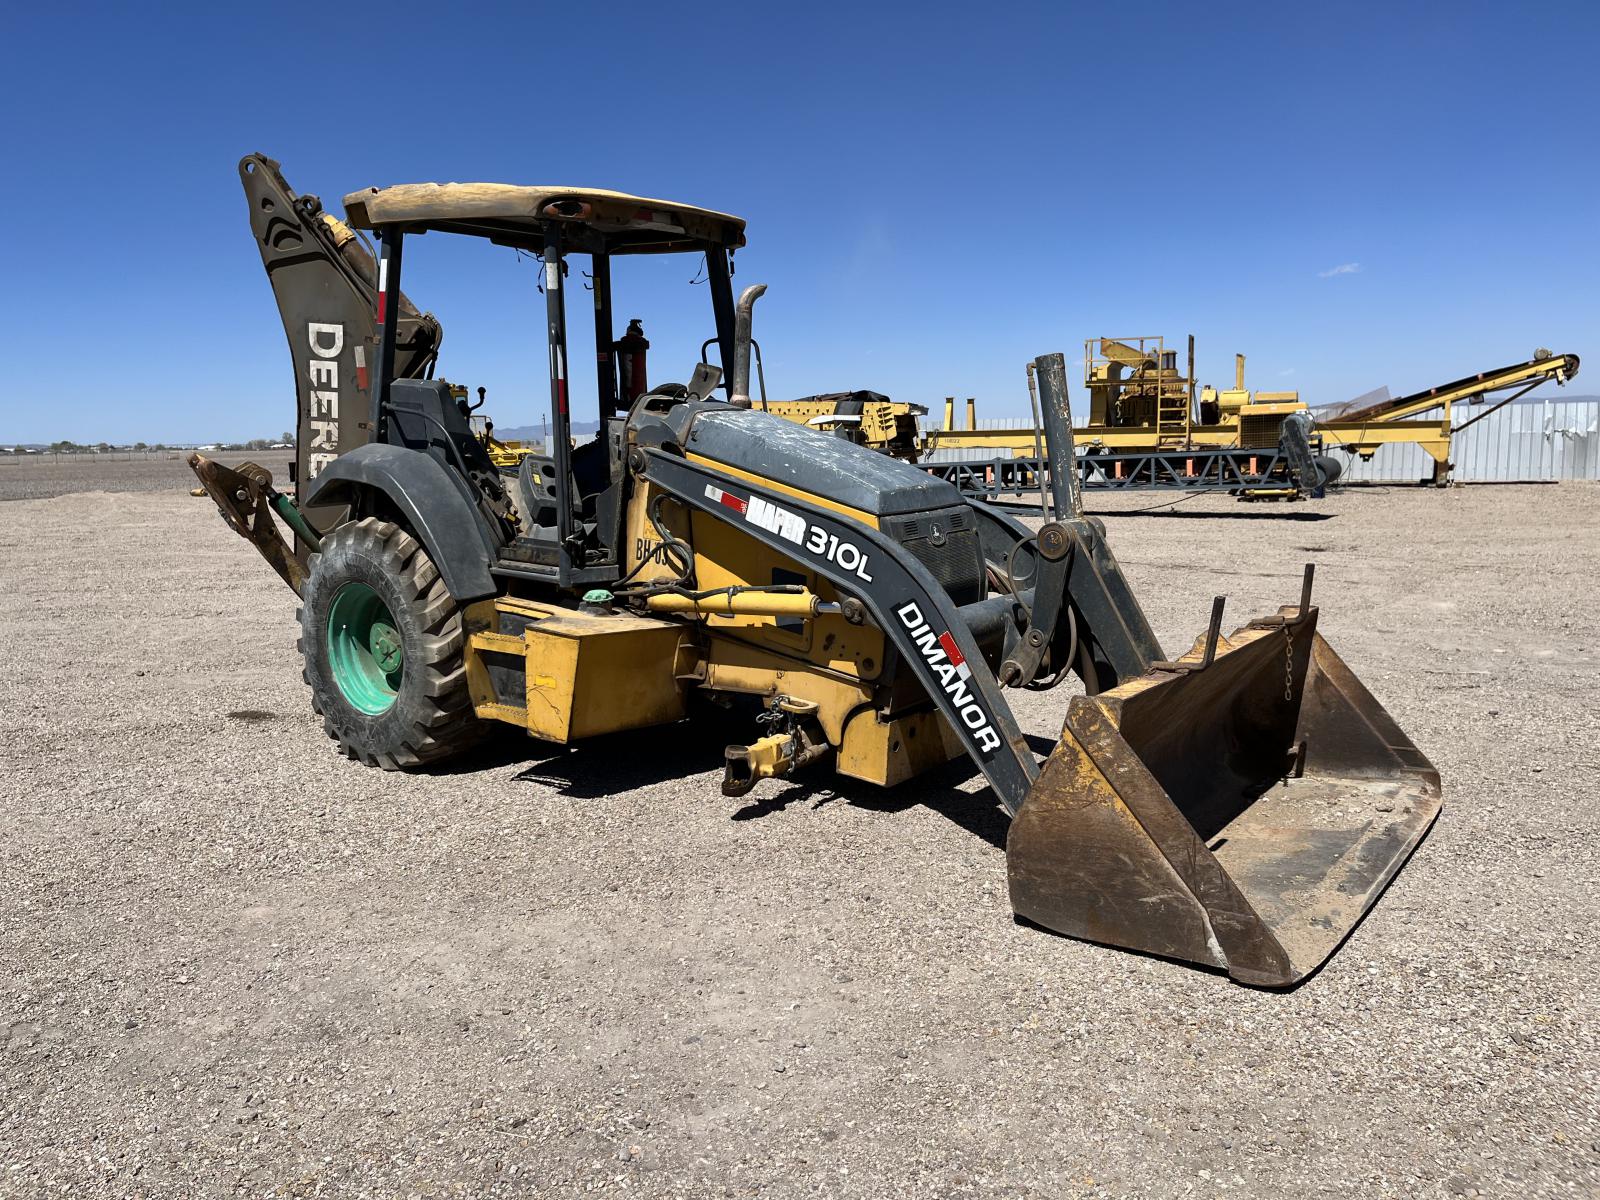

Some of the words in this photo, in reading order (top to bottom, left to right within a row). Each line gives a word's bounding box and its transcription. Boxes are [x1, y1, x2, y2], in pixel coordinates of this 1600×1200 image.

[308, 322, 344, 480] DEERE
[805, 524, 873, 583] 310L
[897, 601, 1001, 753] DIMANOR
